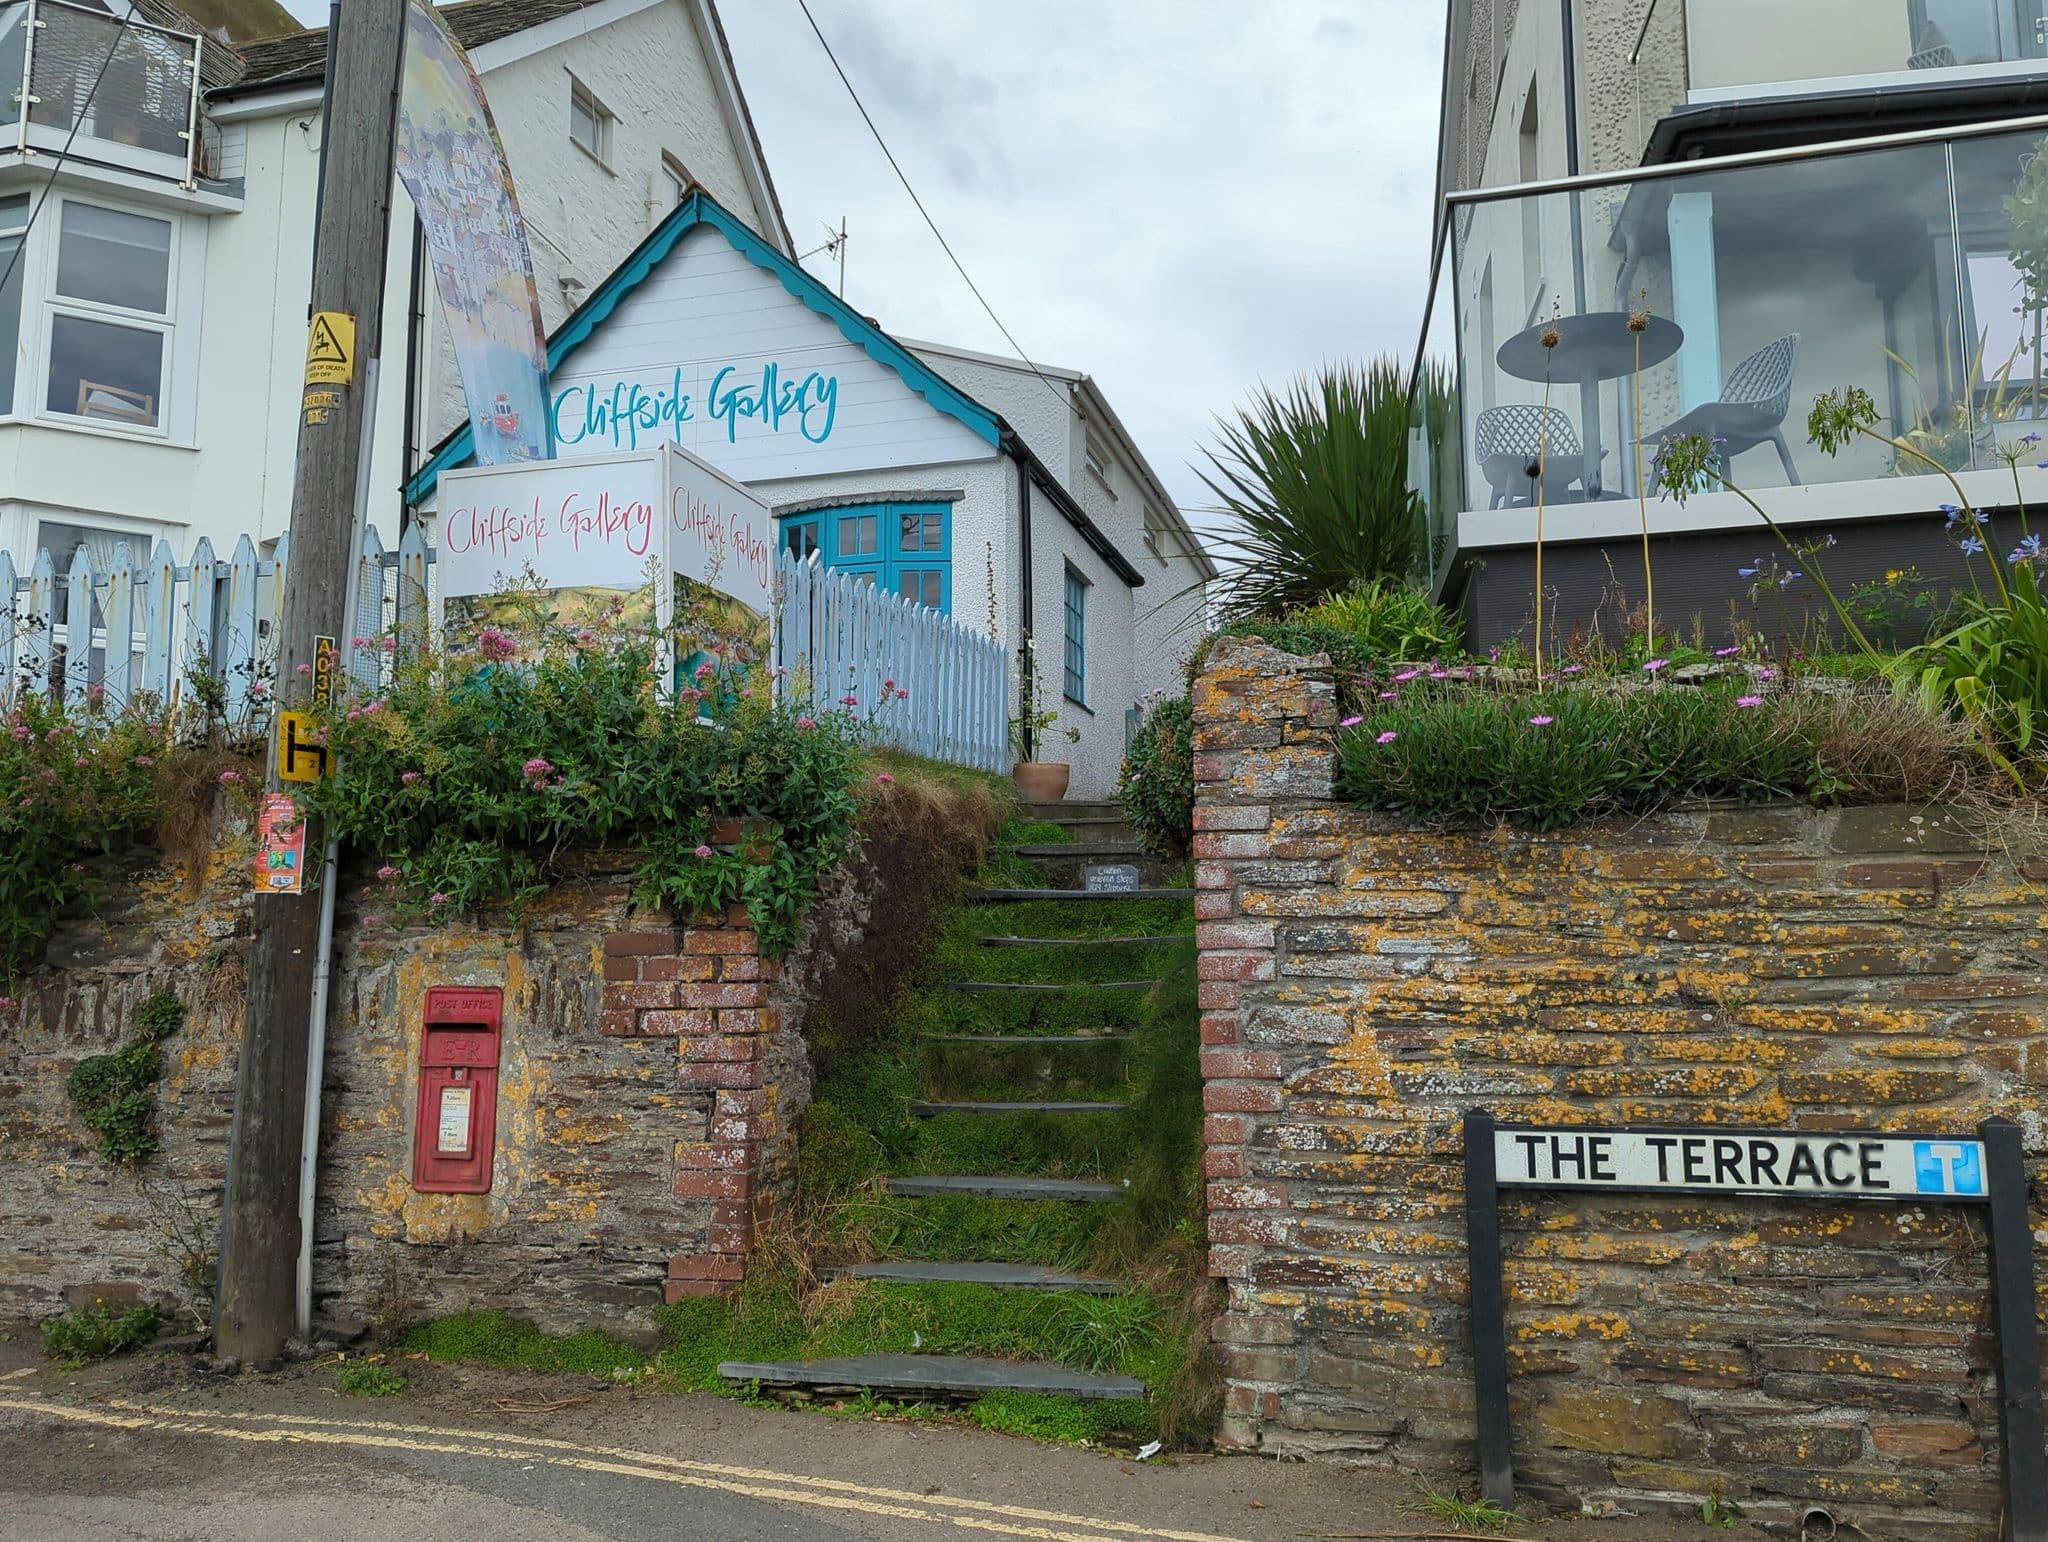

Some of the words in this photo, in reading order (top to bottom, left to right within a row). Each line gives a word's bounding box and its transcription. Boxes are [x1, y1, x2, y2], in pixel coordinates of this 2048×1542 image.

[553, 367, 694, 450] Cliffside
[708, 362, 837, 444] Gallery
[447, 496, 549, 558] Cliffside
[560, 492, 652, 556] Gallery
[673, 487, 726, 553] Cliffside
[730, 513, 768, 589] Gallery
[433, 999, 458, 1009] POST
[461, 1000, 494, 1010] OFFICE
[1515, 1135, 1616, 1181] THE
[1645, 1137, 1891, 1189] TERRACE
